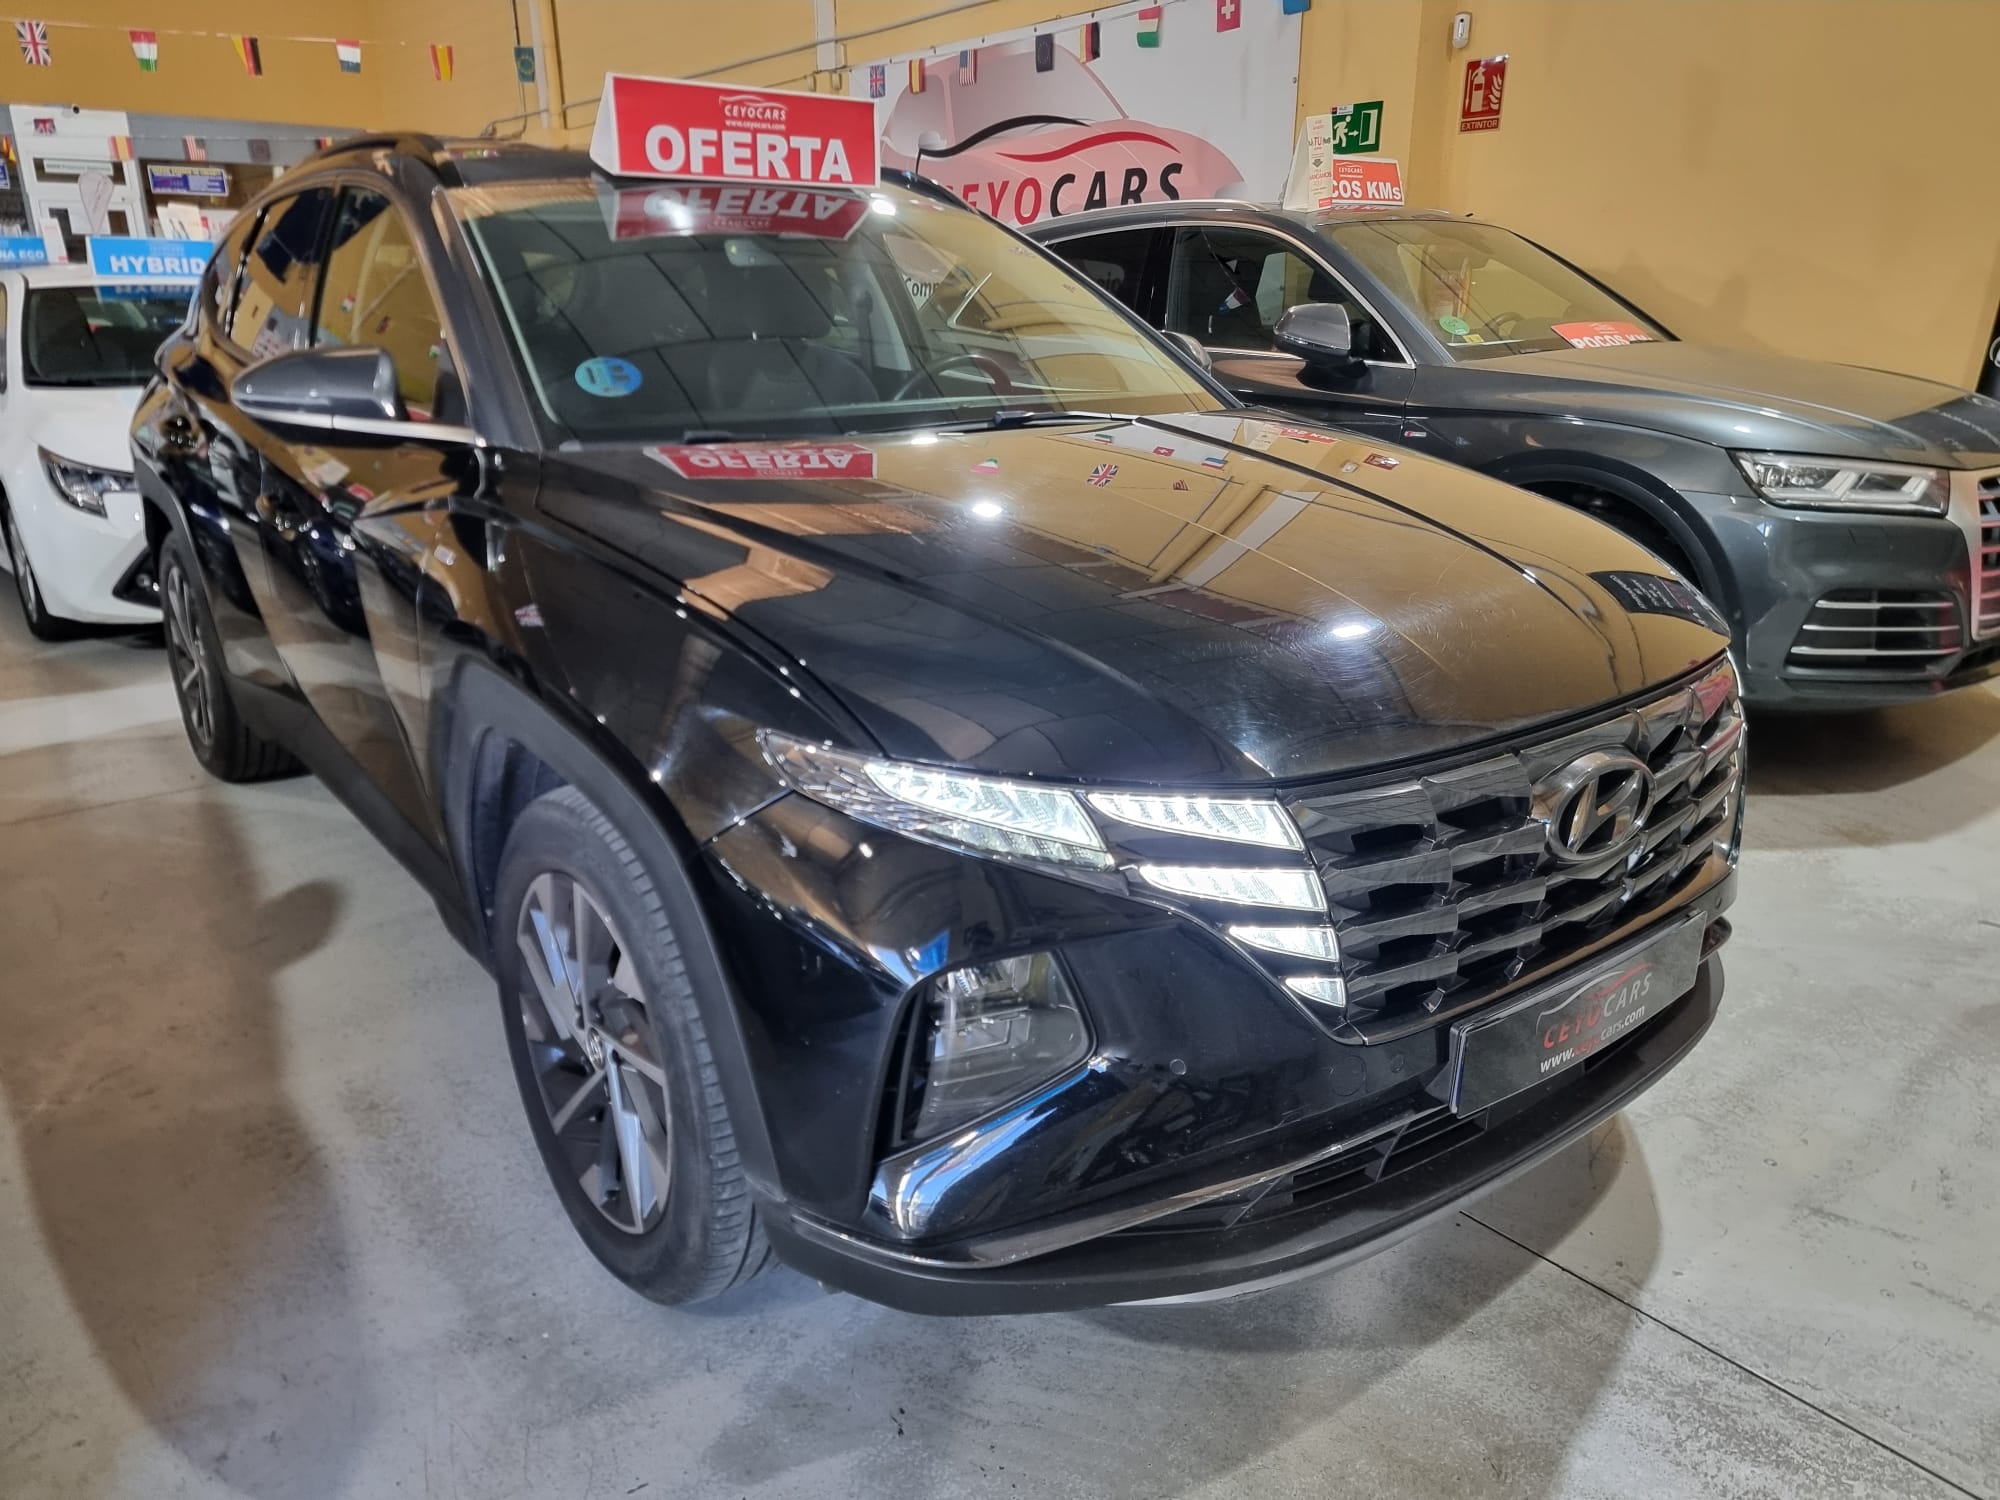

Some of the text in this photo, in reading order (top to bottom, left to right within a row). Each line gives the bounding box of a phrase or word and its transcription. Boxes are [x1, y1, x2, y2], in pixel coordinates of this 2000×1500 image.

[724, 104, 786, 121] CEYOCARS
[1461, 120, 1499, 131] EXTINTOR
[645, 124, 853, 182] OFERTA
[945, 162, 1184, 226] EYOCARS
[1366, 181, 1402, 200] KMs
[109, 255, 206, 274] HYBRID
[1543, 972, 1654, 1049] CEYOCARS
